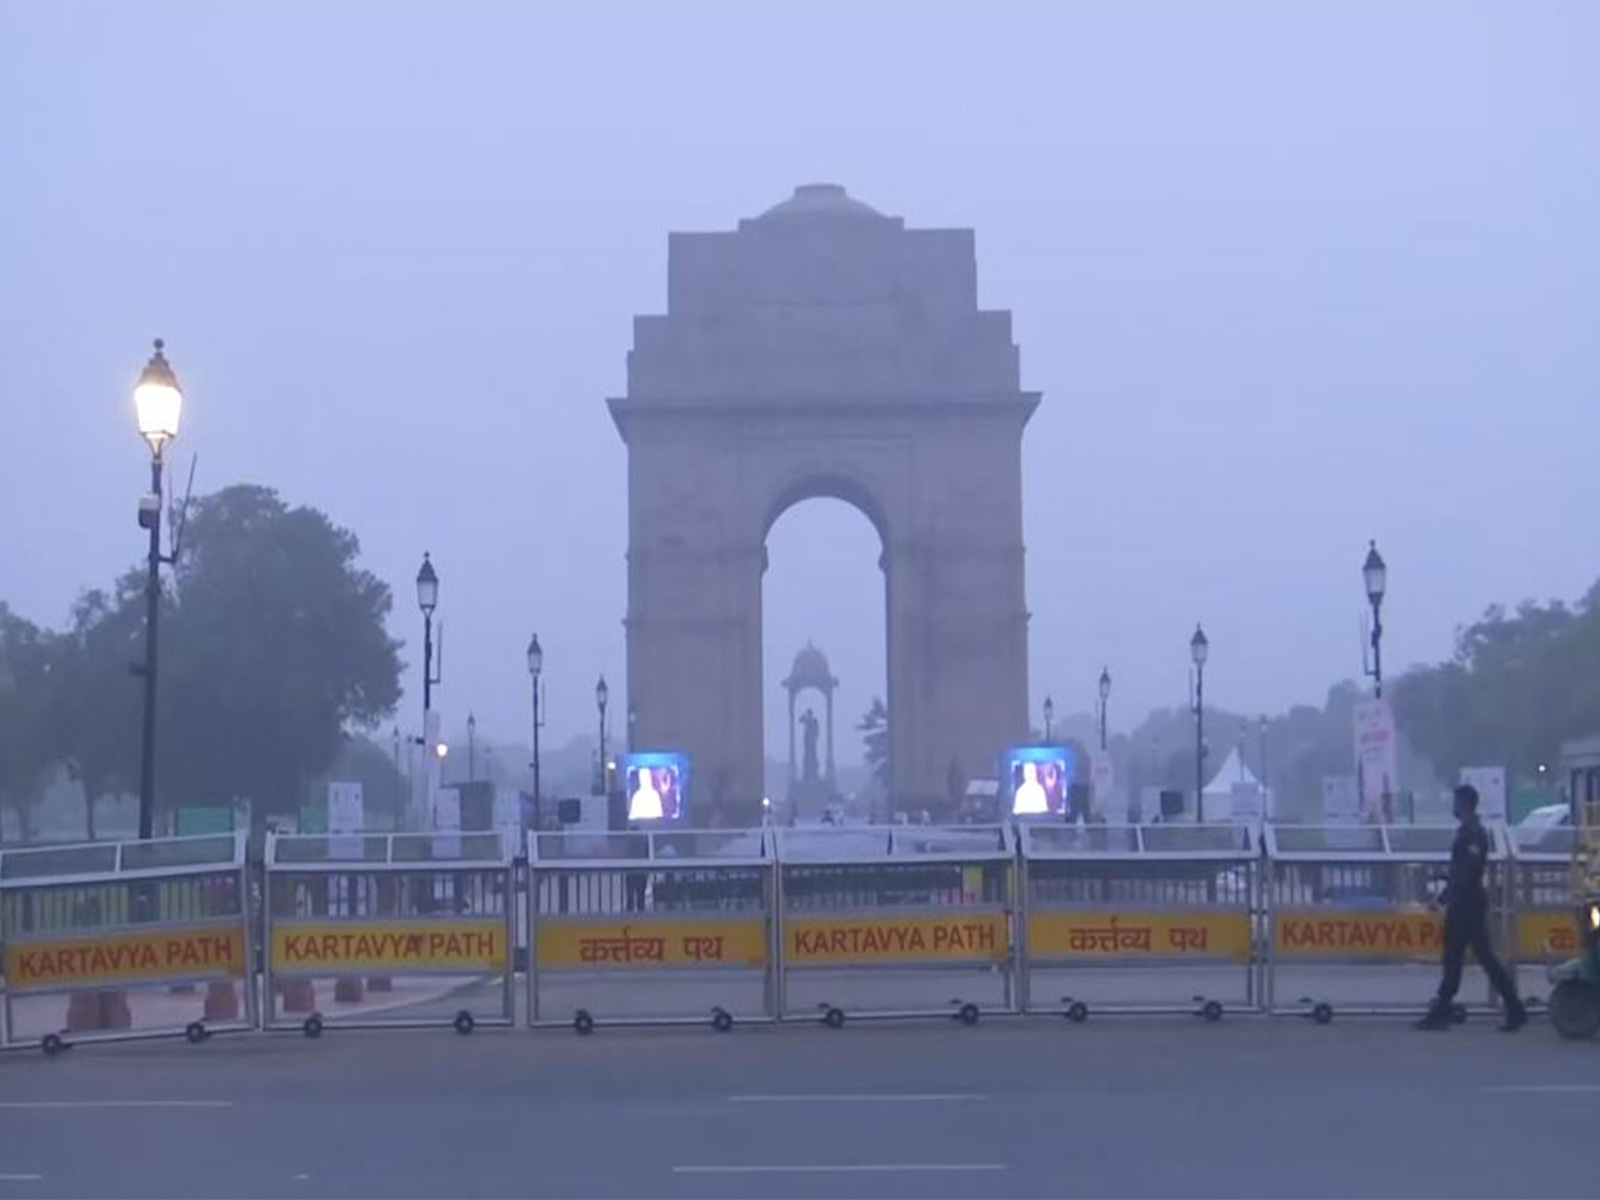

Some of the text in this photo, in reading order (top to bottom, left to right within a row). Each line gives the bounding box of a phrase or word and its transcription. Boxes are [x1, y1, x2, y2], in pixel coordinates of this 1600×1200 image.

[285, 933, 494, 960] KARTAVYA PATH
[795, 925, 994, 953] KARTAVYA PATH
[1168, 927, 1208, 952] पथ
[1282, 921, 1411, 947] KARTAVYA
[19, 936, 232, 978] KARTAVYA PATH
[683, 936, 724, 961] पथ
